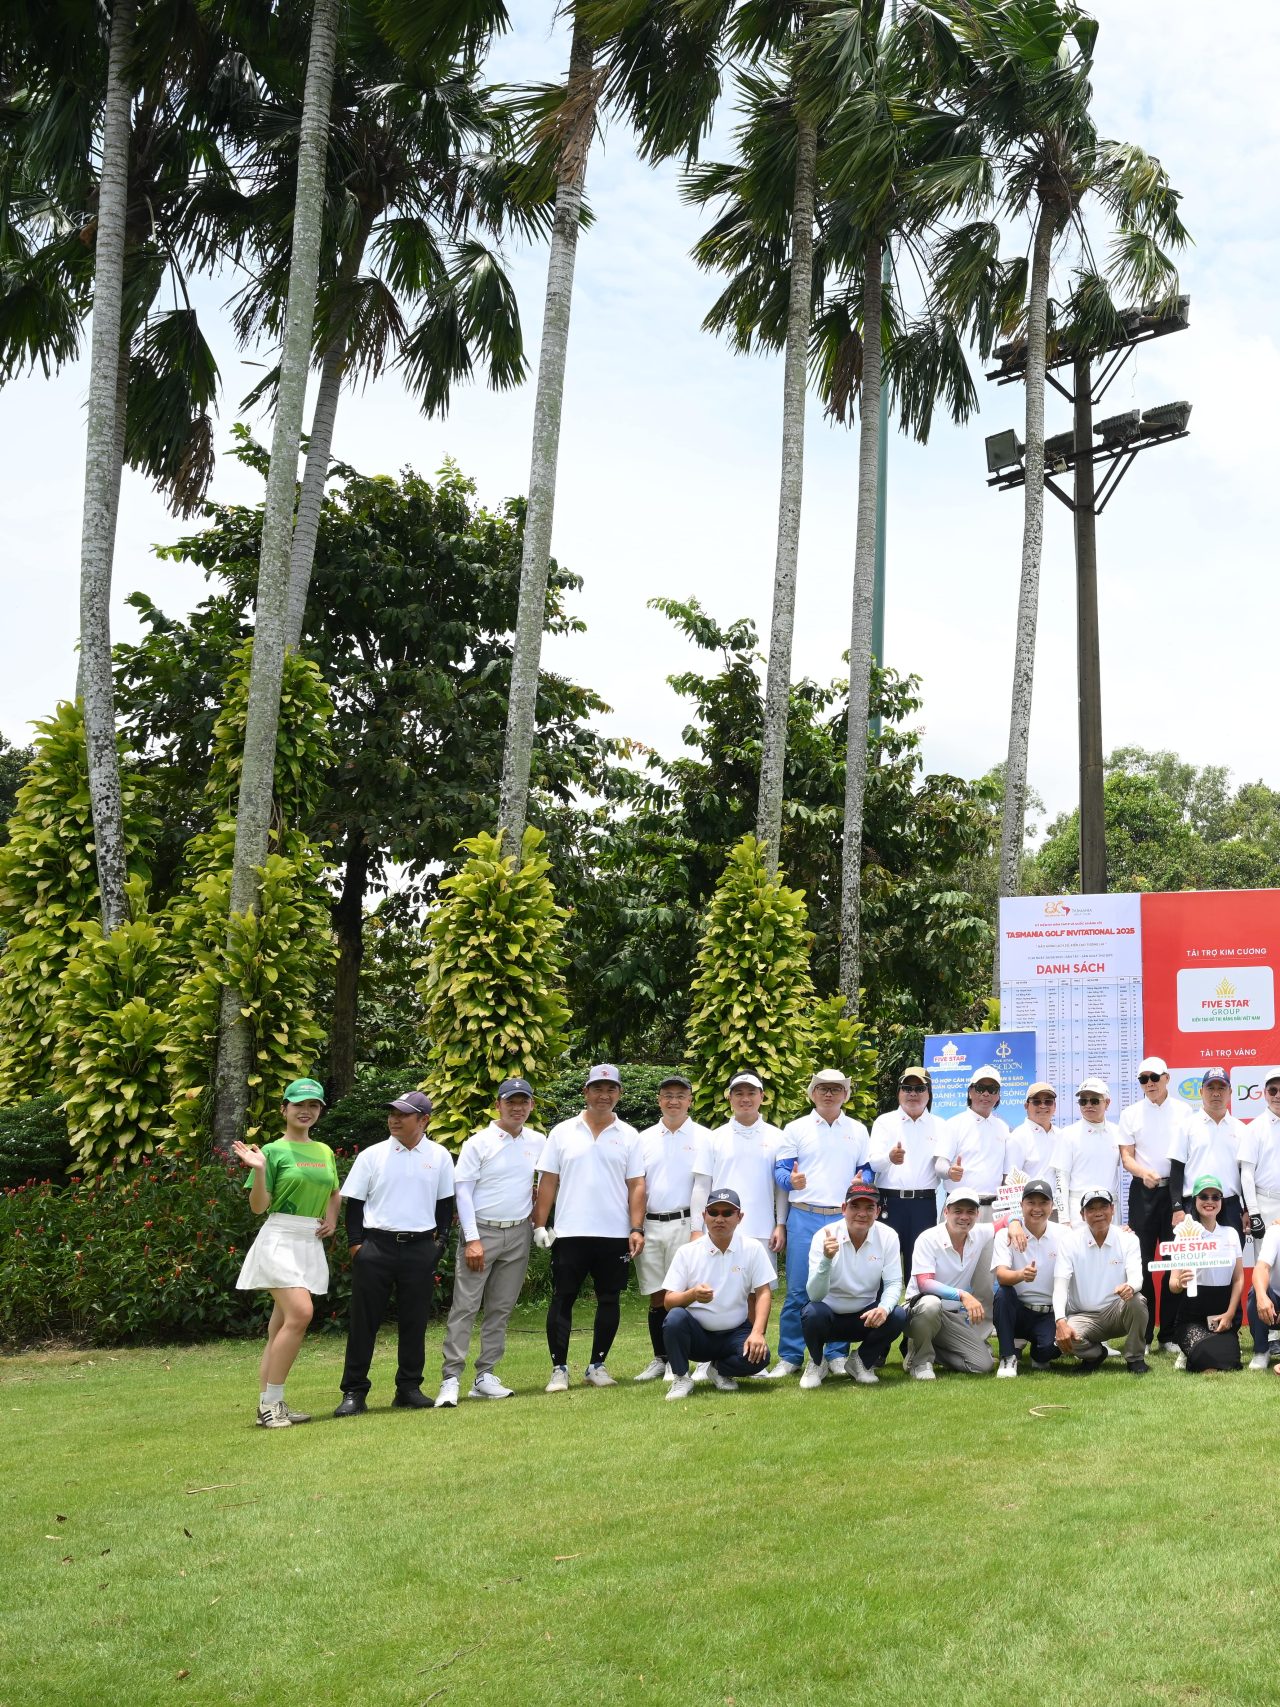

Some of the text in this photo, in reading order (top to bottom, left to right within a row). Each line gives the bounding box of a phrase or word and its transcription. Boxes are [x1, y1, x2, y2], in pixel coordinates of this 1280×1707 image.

[1006, 927, 1135, 939] TASMANIA GOLF INVITATIONAL 2025
[1186, 947, 1267, 958] TÀI TRỢ KIM CƯƠNG
[1036, 961, 1105, 975] DANH SÁCH
[1201, 1000, 1223, 1008] FIVE
[1200, 1048, 1257, 1058] TÀI TRỢ VÀNG
[999, 1187, 1013, 1195] FIVE
[1162, 1241, 1217, 1253] FIVE STAR
[1173, 1252, 1207, 1261] GROUP
